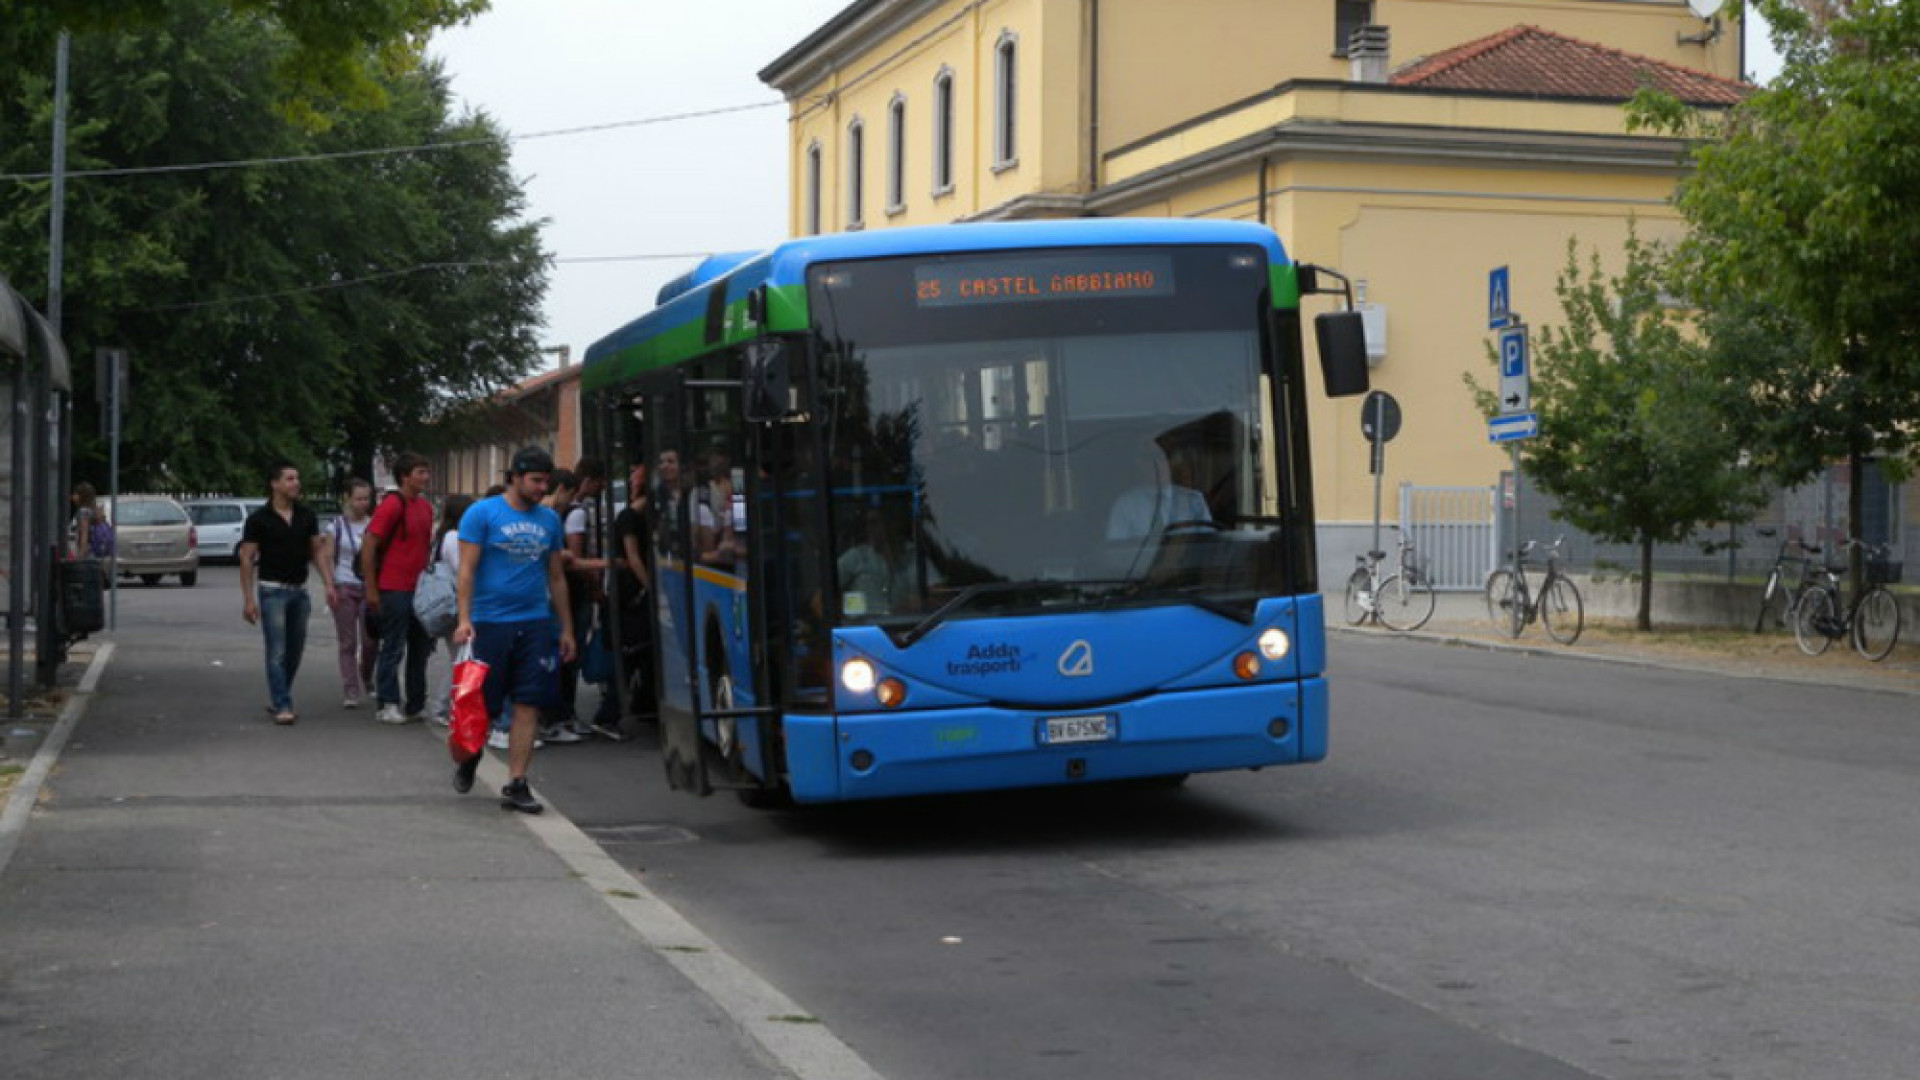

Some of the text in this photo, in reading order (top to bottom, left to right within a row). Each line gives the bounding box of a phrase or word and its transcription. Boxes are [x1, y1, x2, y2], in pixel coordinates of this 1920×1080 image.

[917, 279, 941, 299] 25
[959, 276, 1040, 298] CASTEL
[1506, 340, 1520, 374] P
[967, 643, 1021, 660] Adda
[947, 659, 1021, 677] trasporti
